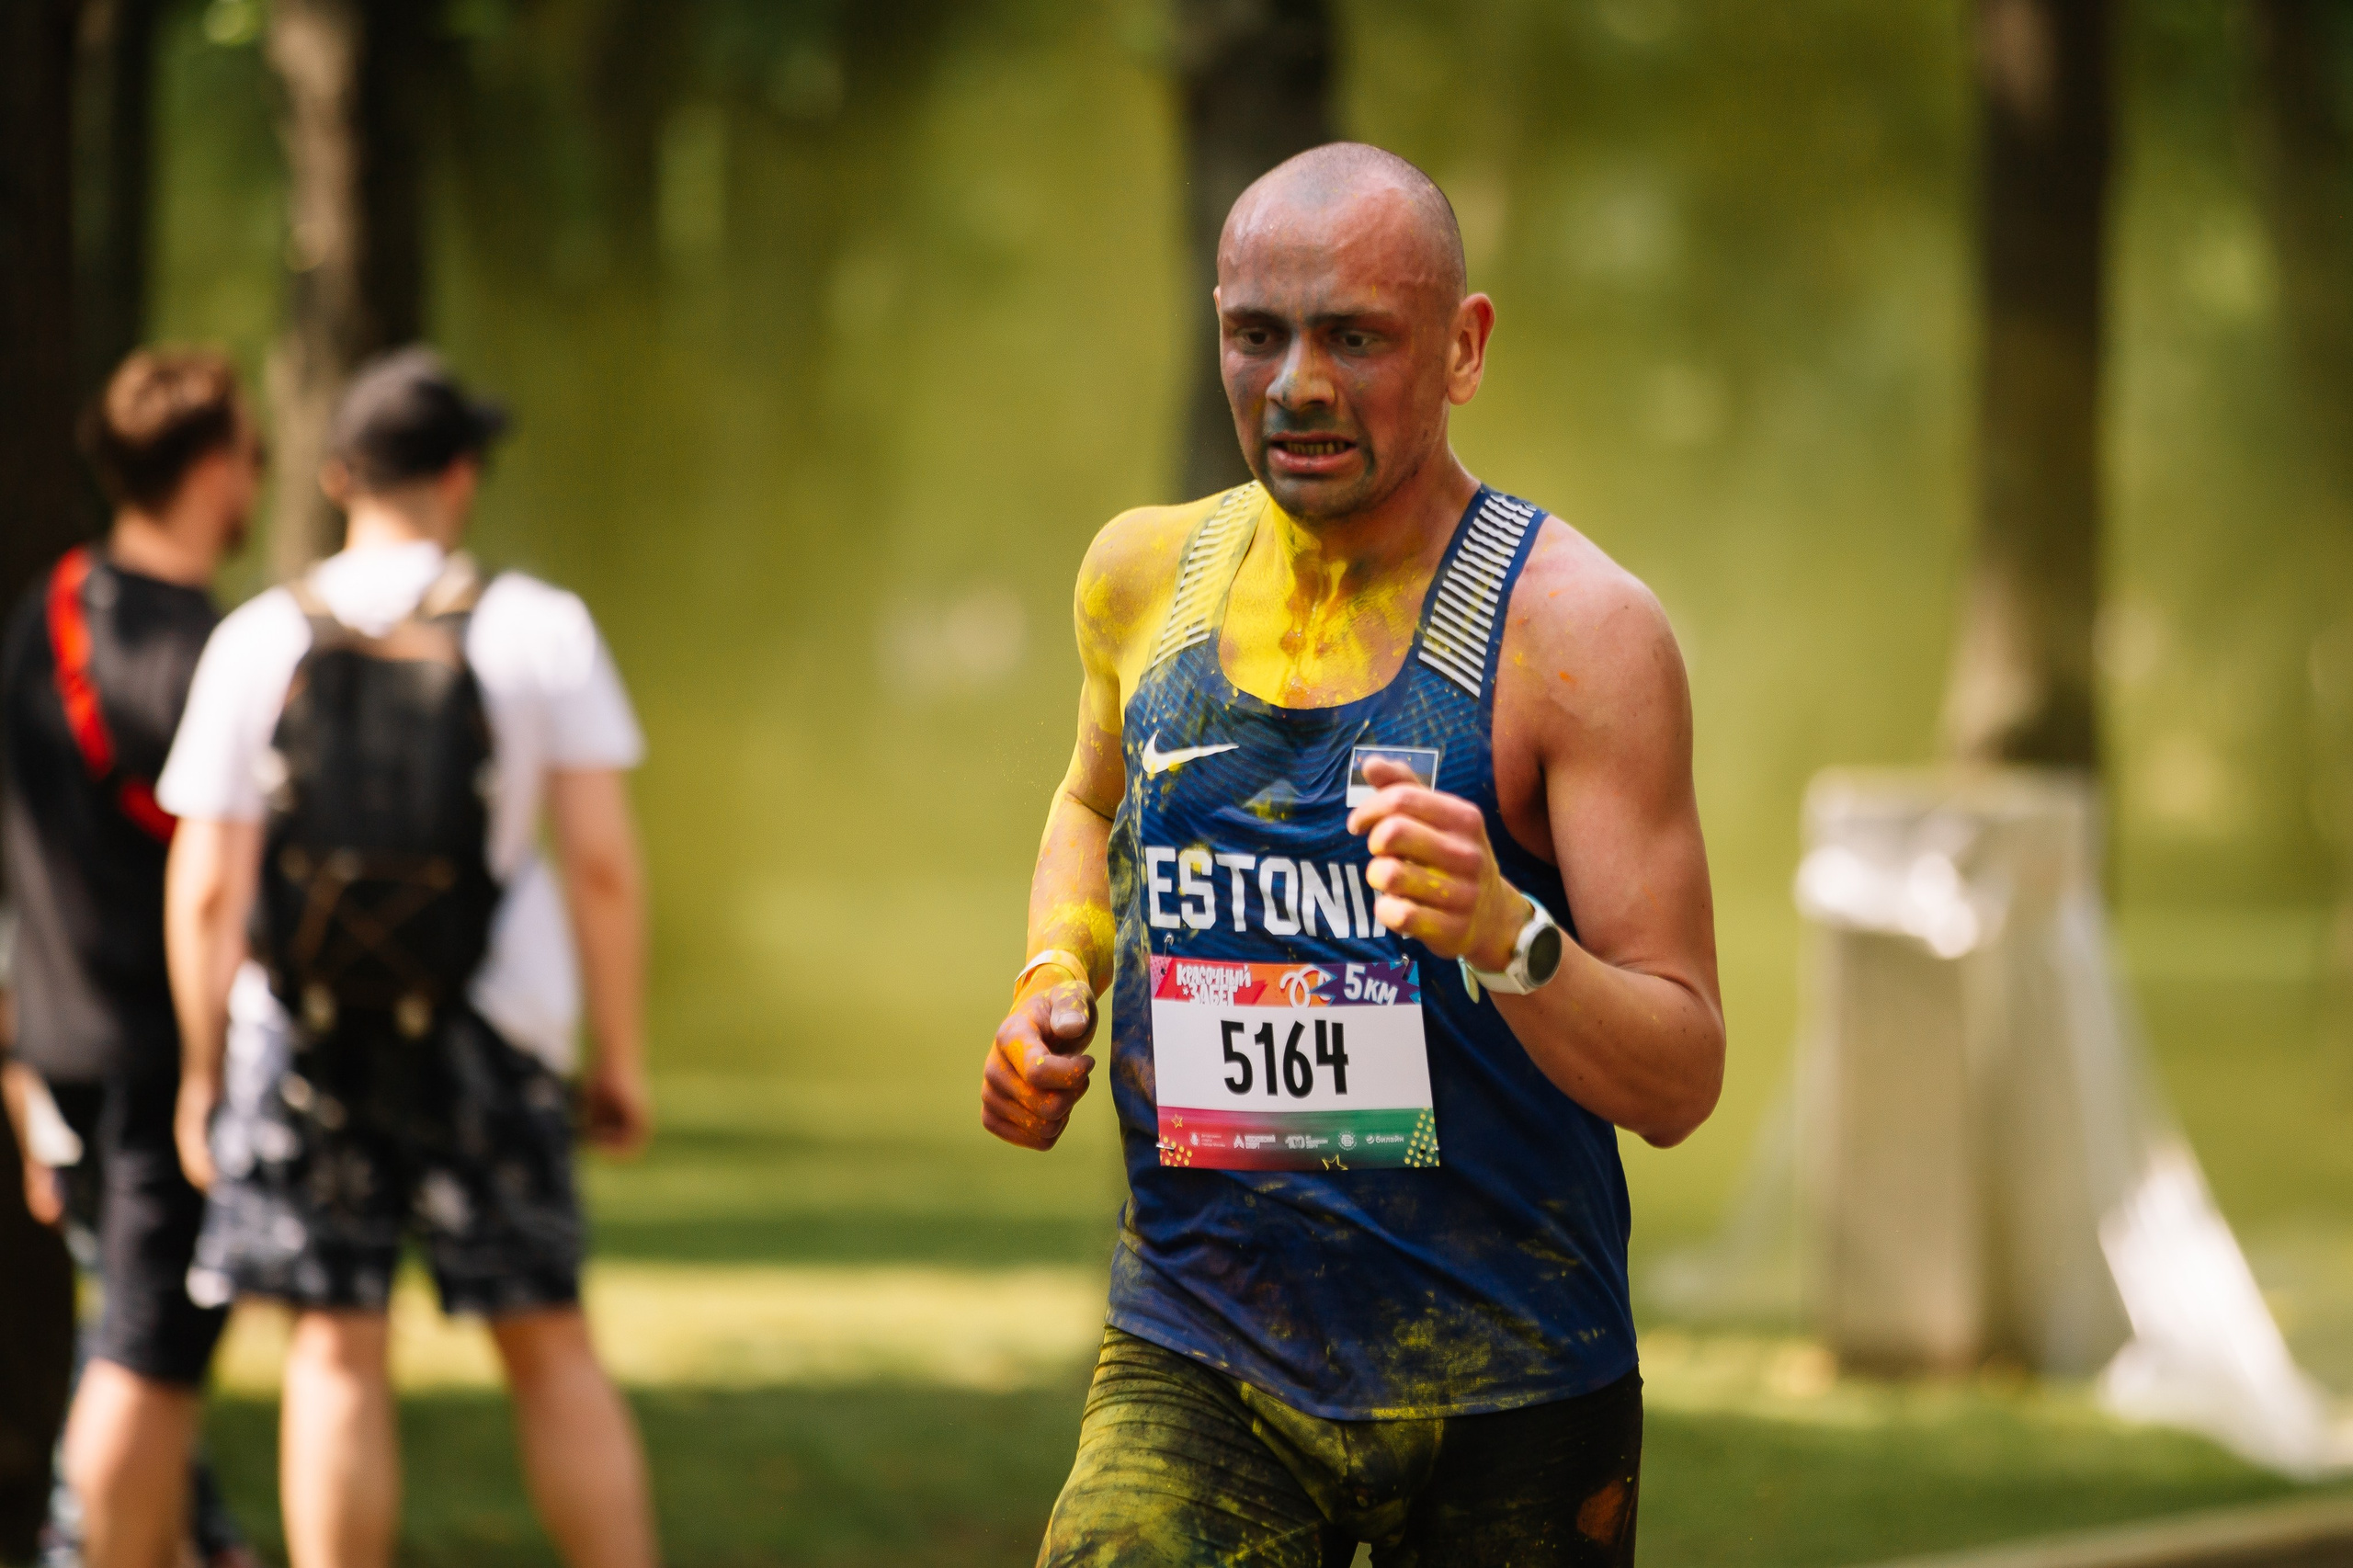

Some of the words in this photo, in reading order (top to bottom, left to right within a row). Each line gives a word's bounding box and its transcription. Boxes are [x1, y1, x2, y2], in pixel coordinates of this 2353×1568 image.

[1176, 963, 1252, 989] КРАСОЧНЫЙ
[1221, 1019, 1349, 1098] 5164
[1375, 1134, 1404, 1145] билайн
